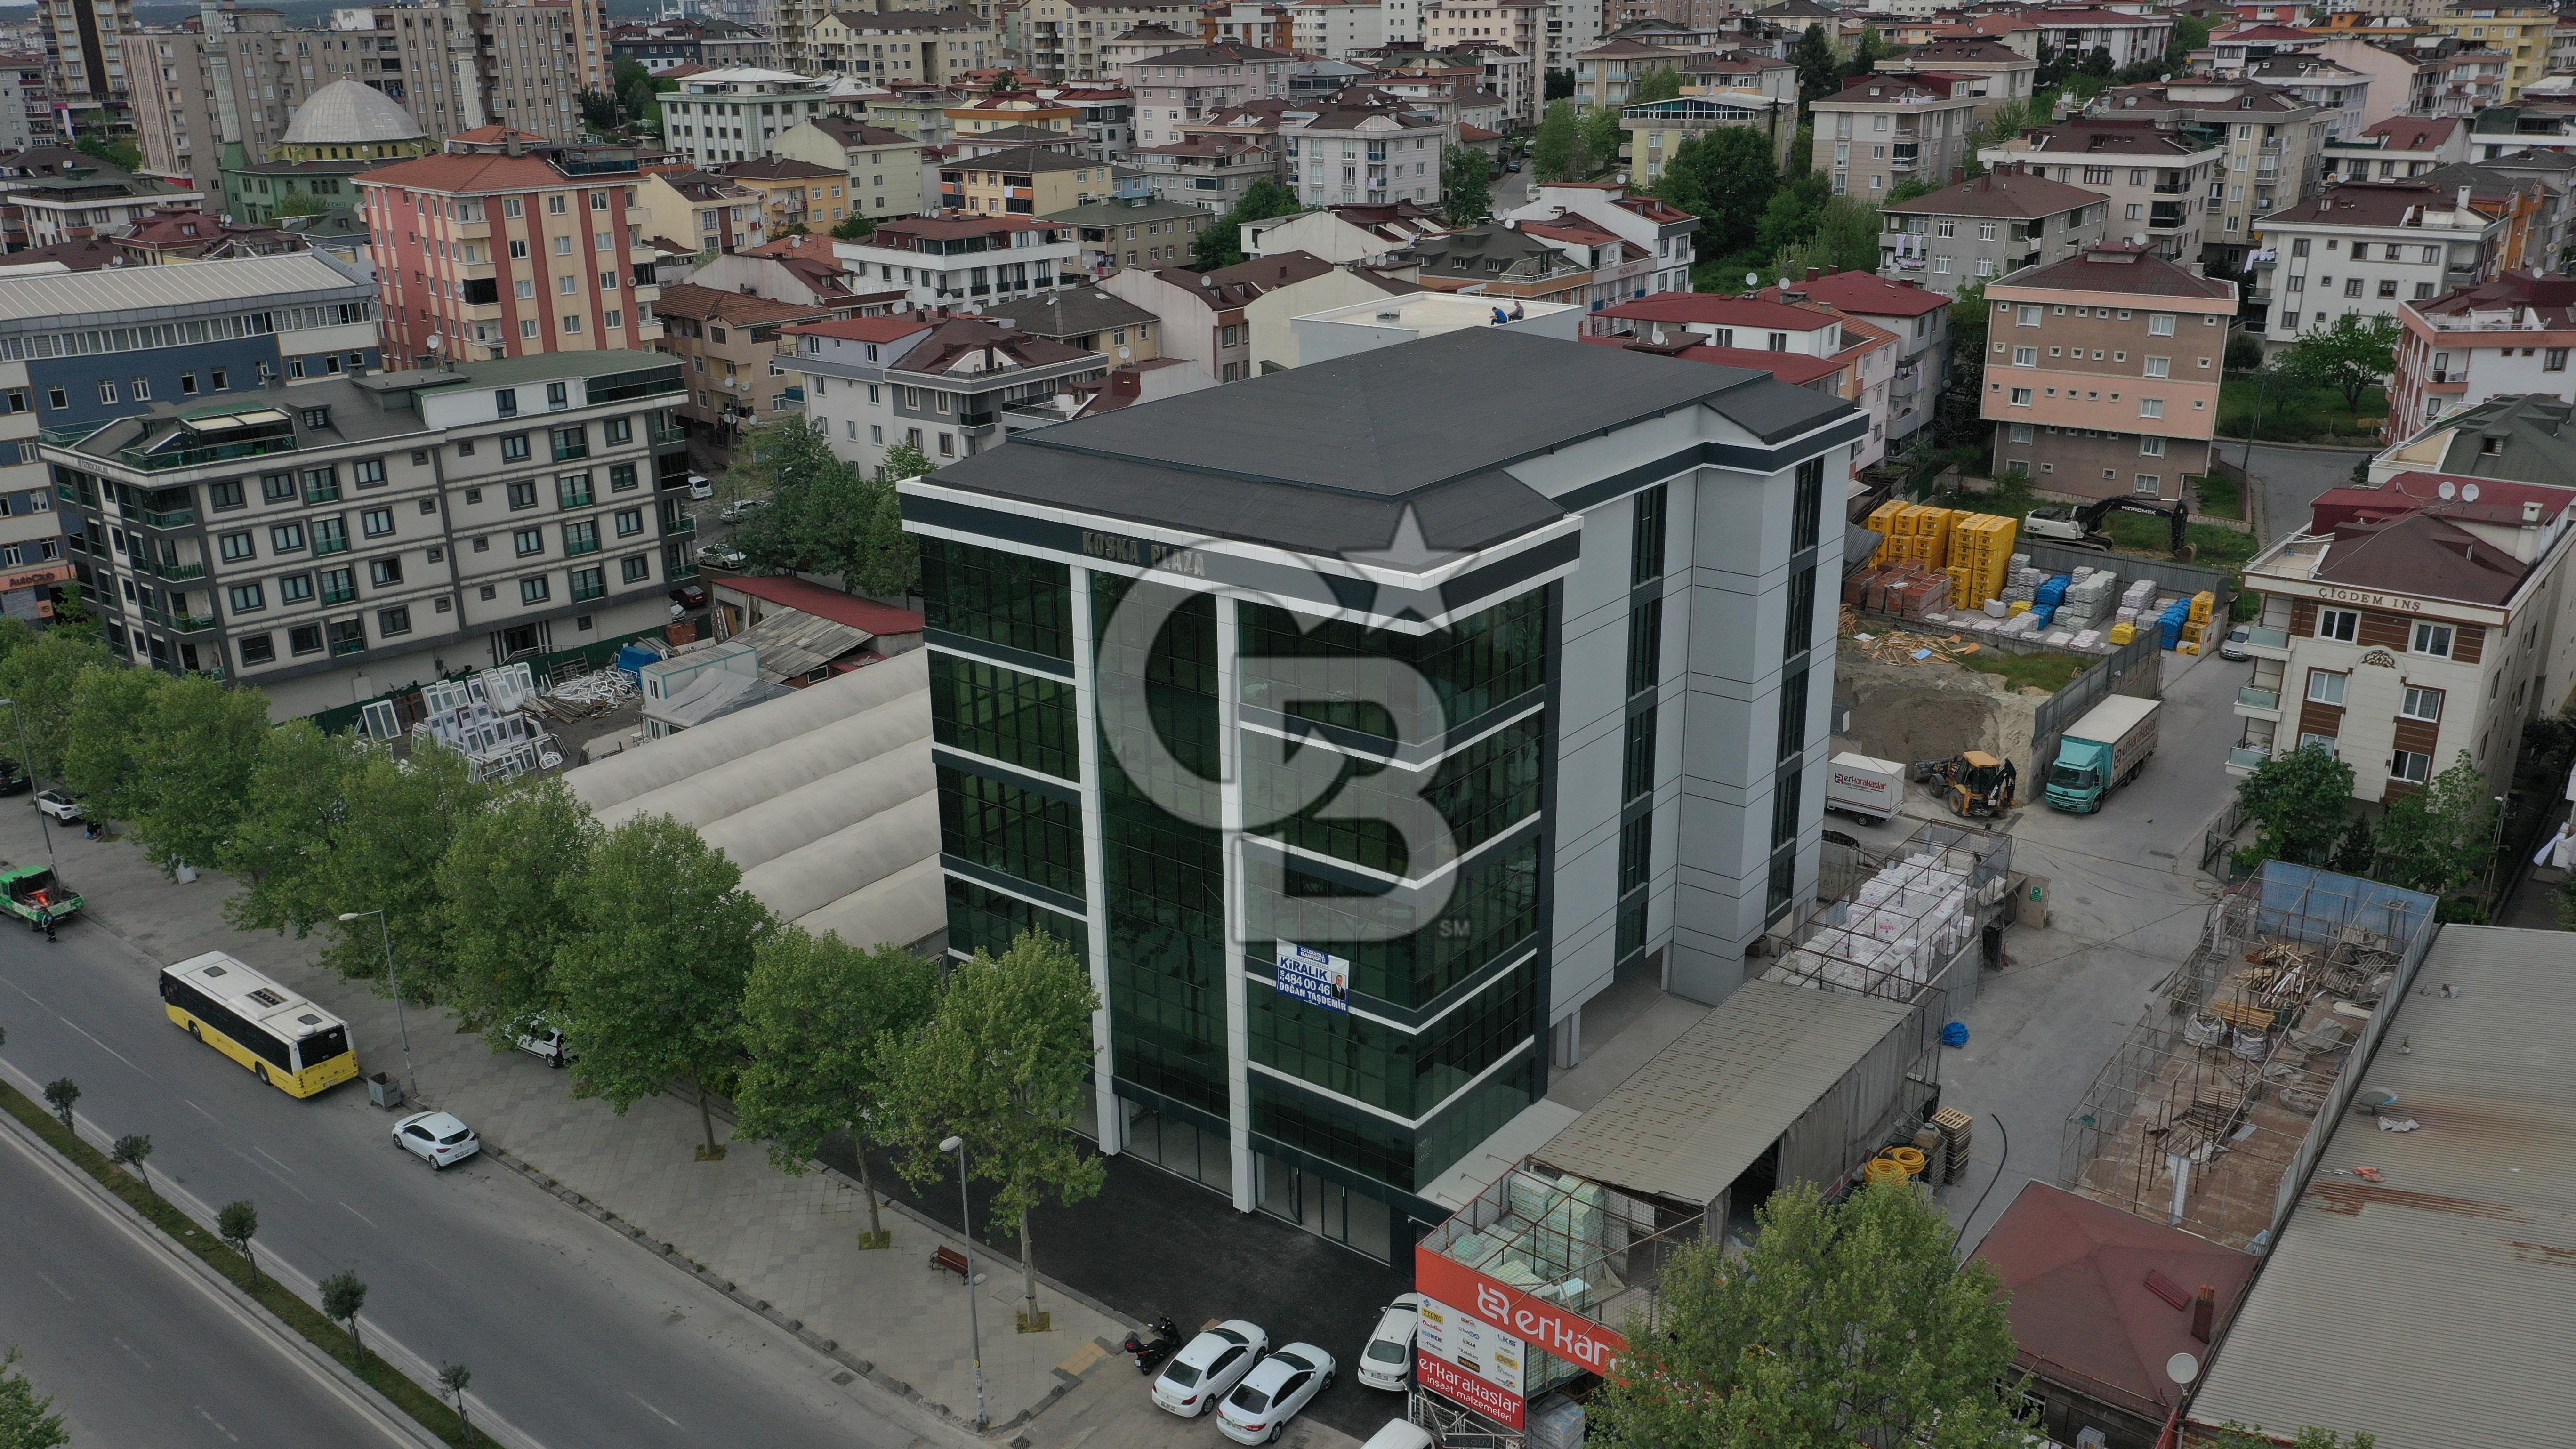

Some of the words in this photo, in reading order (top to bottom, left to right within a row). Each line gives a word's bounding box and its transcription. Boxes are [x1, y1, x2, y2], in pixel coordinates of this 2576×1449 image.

[1083, 531, 1140, 563] KOSKA
[1151, 544, 1205, 577] PLAZA
[9, 572, 55, 587] AutoClub
[1279, 982, 1305, 998] DOĞAN
[1307, 990, 1346, 1011] TAŞDEMİR
[1285, 973, 1302, 987] 484
[1304, 978, 1316, 991] 00
[1318, 983, 1330, 996] 46
[1423, 1309, 1442, 1322] YTONG
[1419, 1358, 1520, 1414] erkarakaşlar
[1427, 1374, 1454, 1394] inşaat
[1457, 1391, 1511, 1422] malzemeleri
